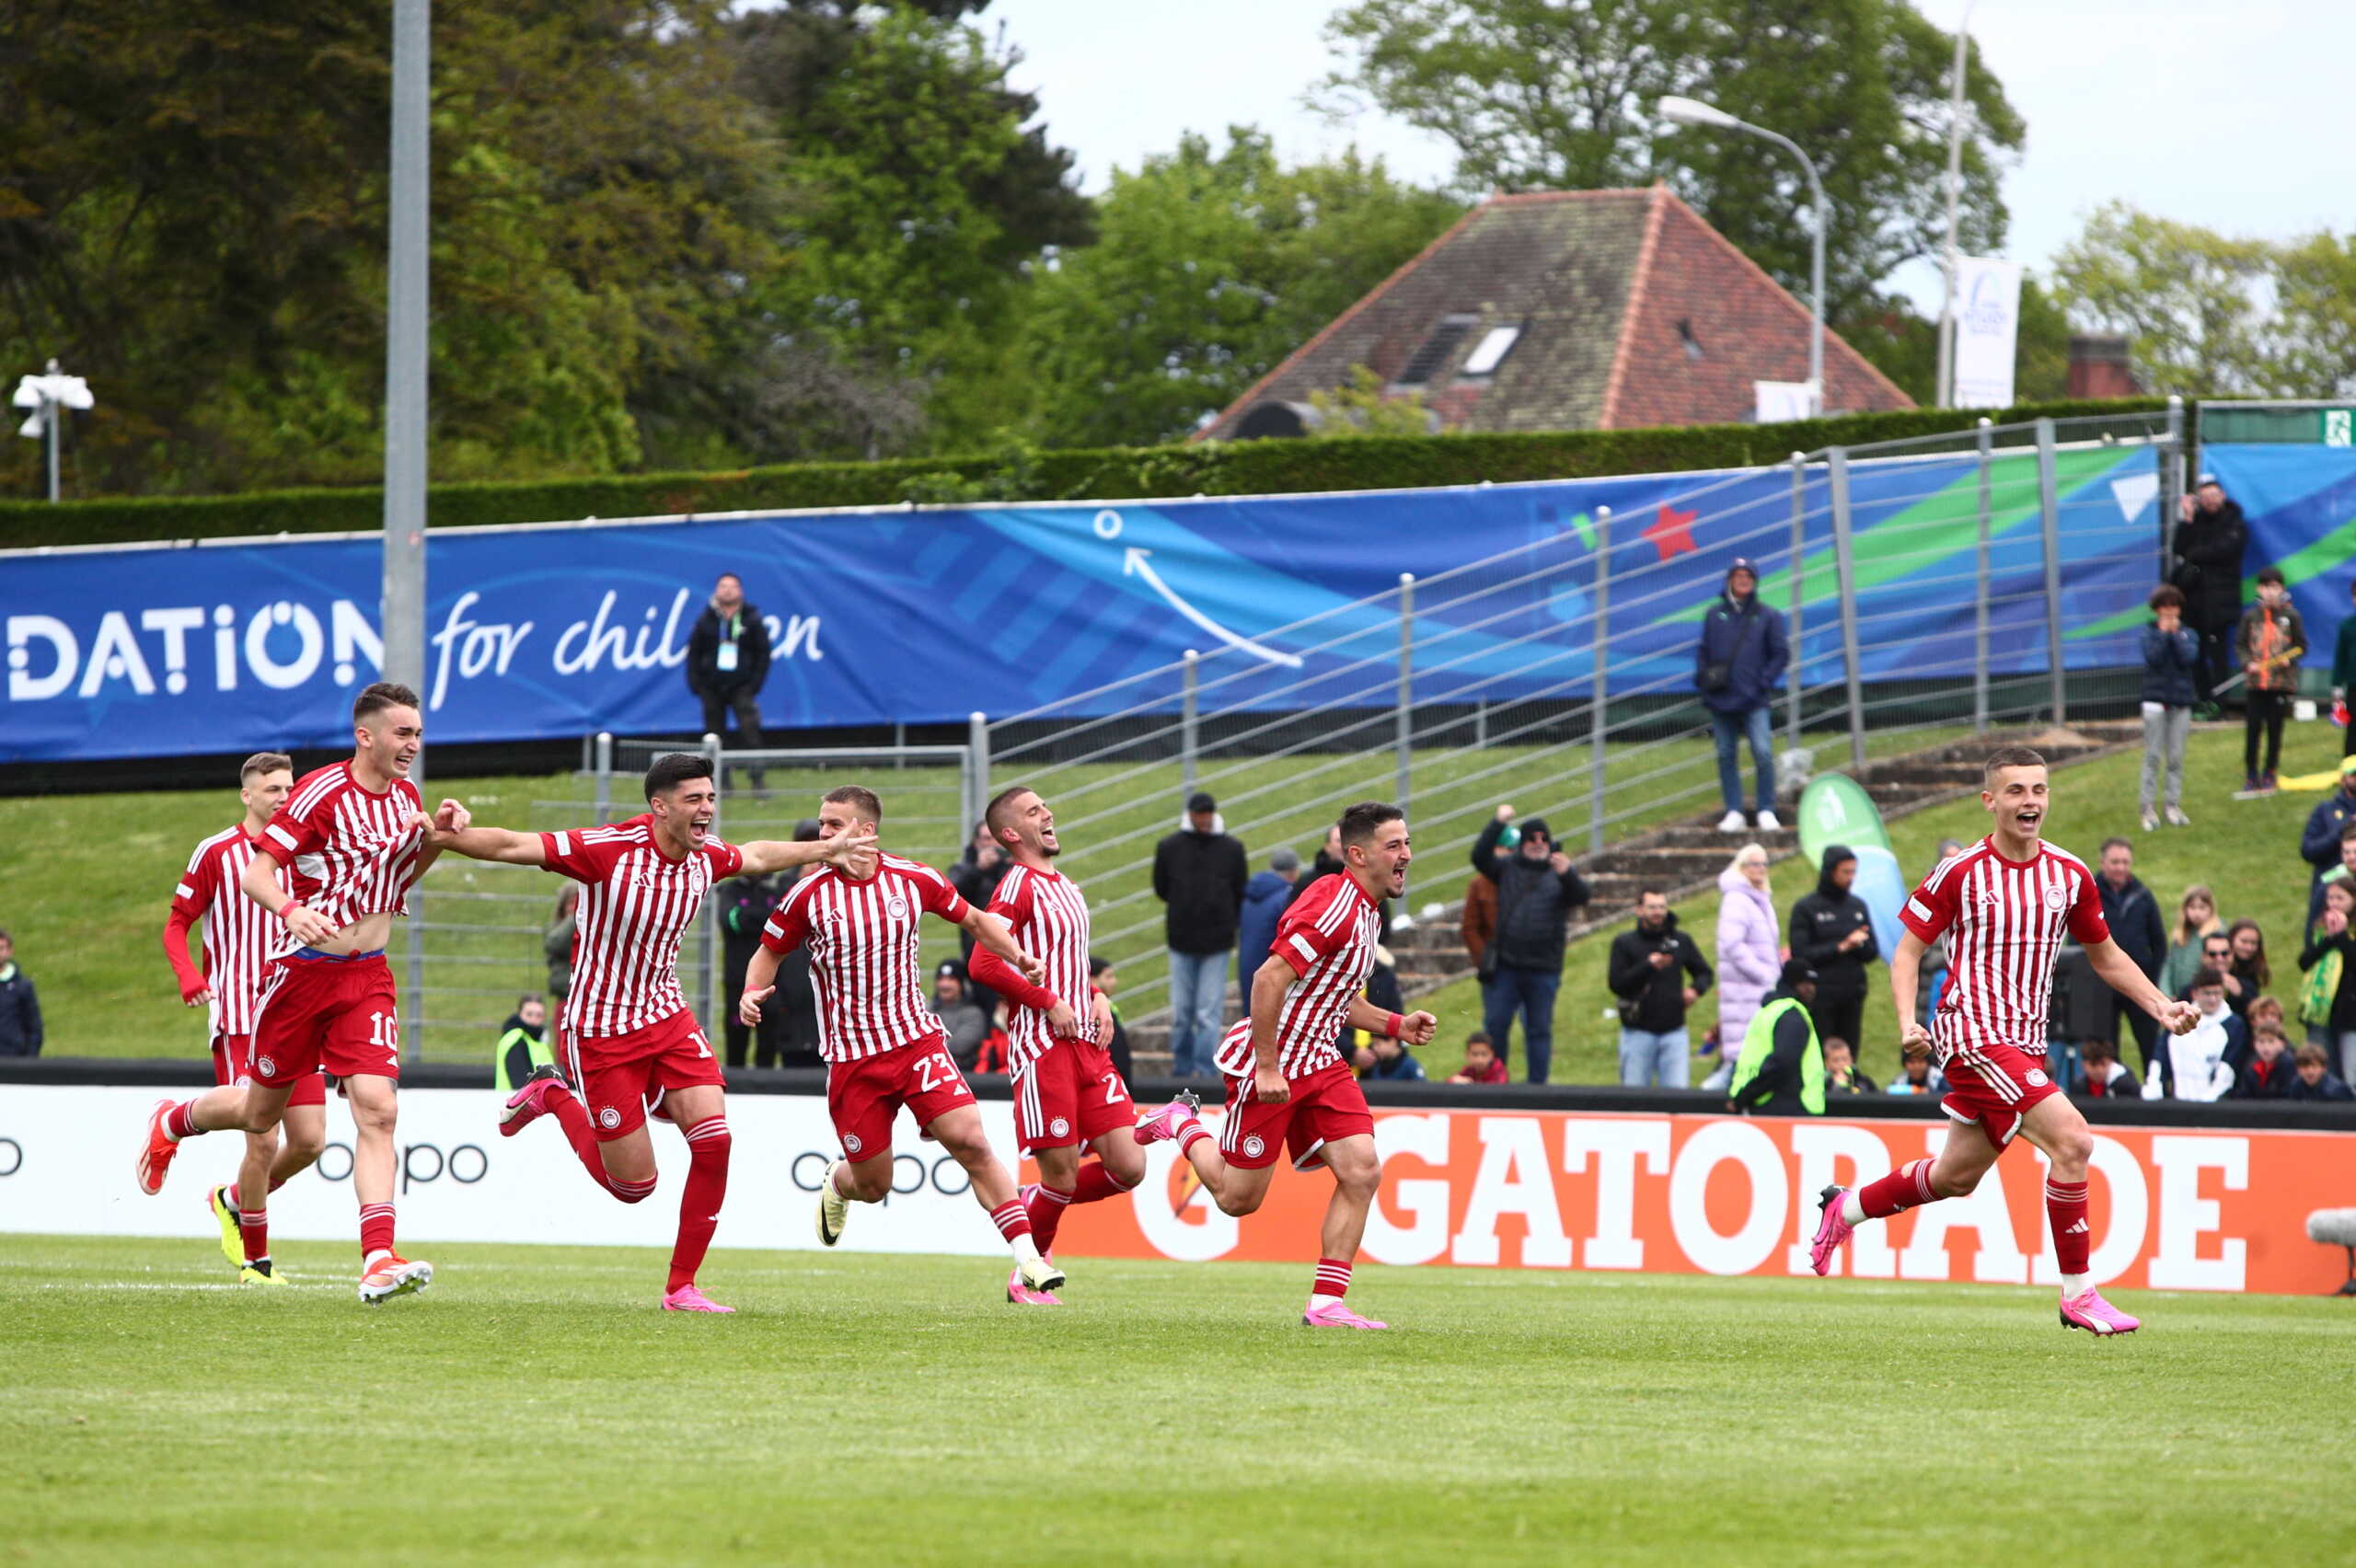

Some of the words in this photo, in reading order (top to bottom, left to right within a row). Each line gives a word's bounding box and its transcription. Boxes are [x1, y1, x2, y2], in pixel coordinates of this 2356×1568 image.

[429, 591, 534, 712] for
[553, 586, 824, 675] chilen
[912, 1052, 958, 1092] 23
[1101, 1072, 1130, 1105] 2
[317, 1142, 488, 1195] opo
[1358, 1113, 2250, 1291] GATORADE
